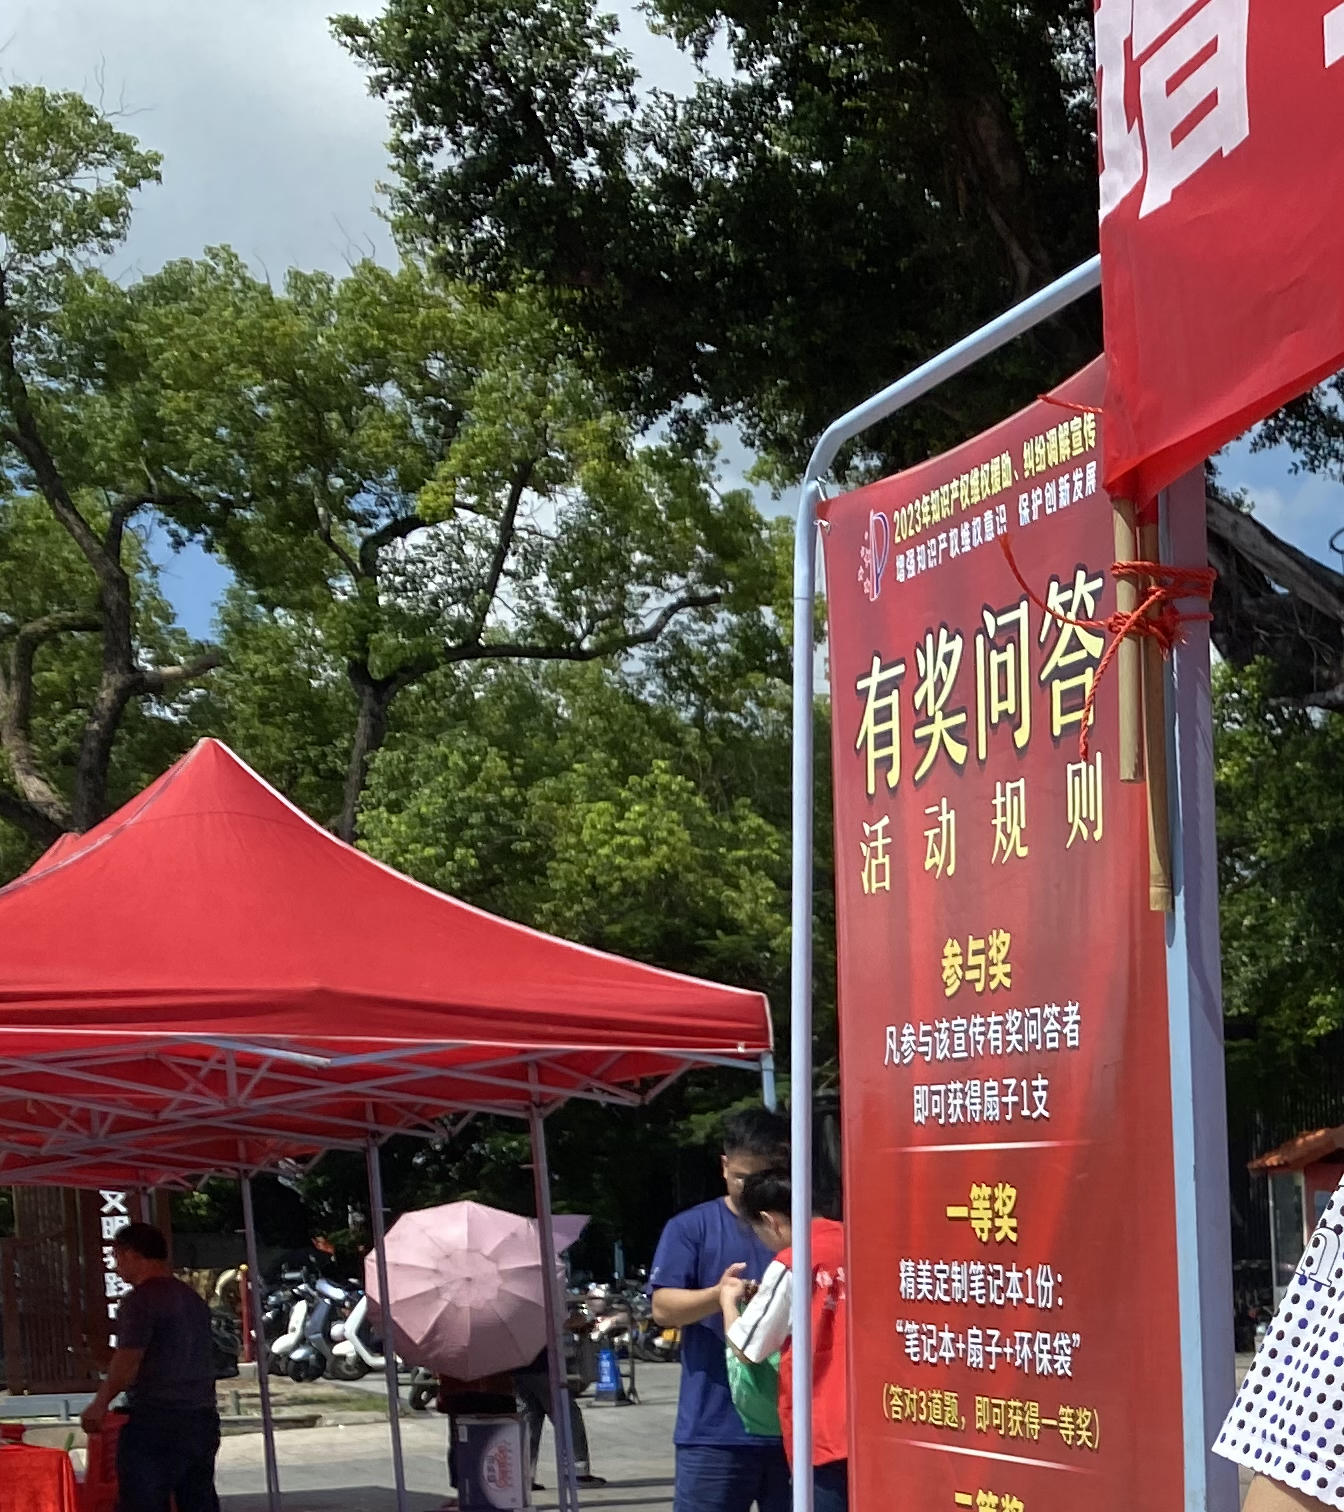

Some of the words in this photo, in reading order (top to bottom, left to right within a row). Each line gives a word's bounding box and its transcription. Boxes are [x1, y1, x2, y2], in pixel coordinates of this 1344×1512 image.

[896, 503, 1007, 582] 增强知识产权维权意识
[1019, 461, 1097, 527] 保护创新发展
[856, 570, 1104, 795] 有奖问答
[860, 752, 1104, 895] 活动规则
[941, 929, 1013, 998] 参与奖
[884, 1000, 1082, 1066] 凡参与该宣传有奖问答者
[913, 1073, 1051, 1125] 即可获得扇子1支
[946, 1183, 1018, 1243] 一等奖
[899, 1258, 1064, 1308] 精美定制笔记本1份：
[896, 1318, 1081, 1378] “笔记本+扇子+环保袋”
[882, 1383, 1100, 1449] （答对3道题，即可获得一等奖）
